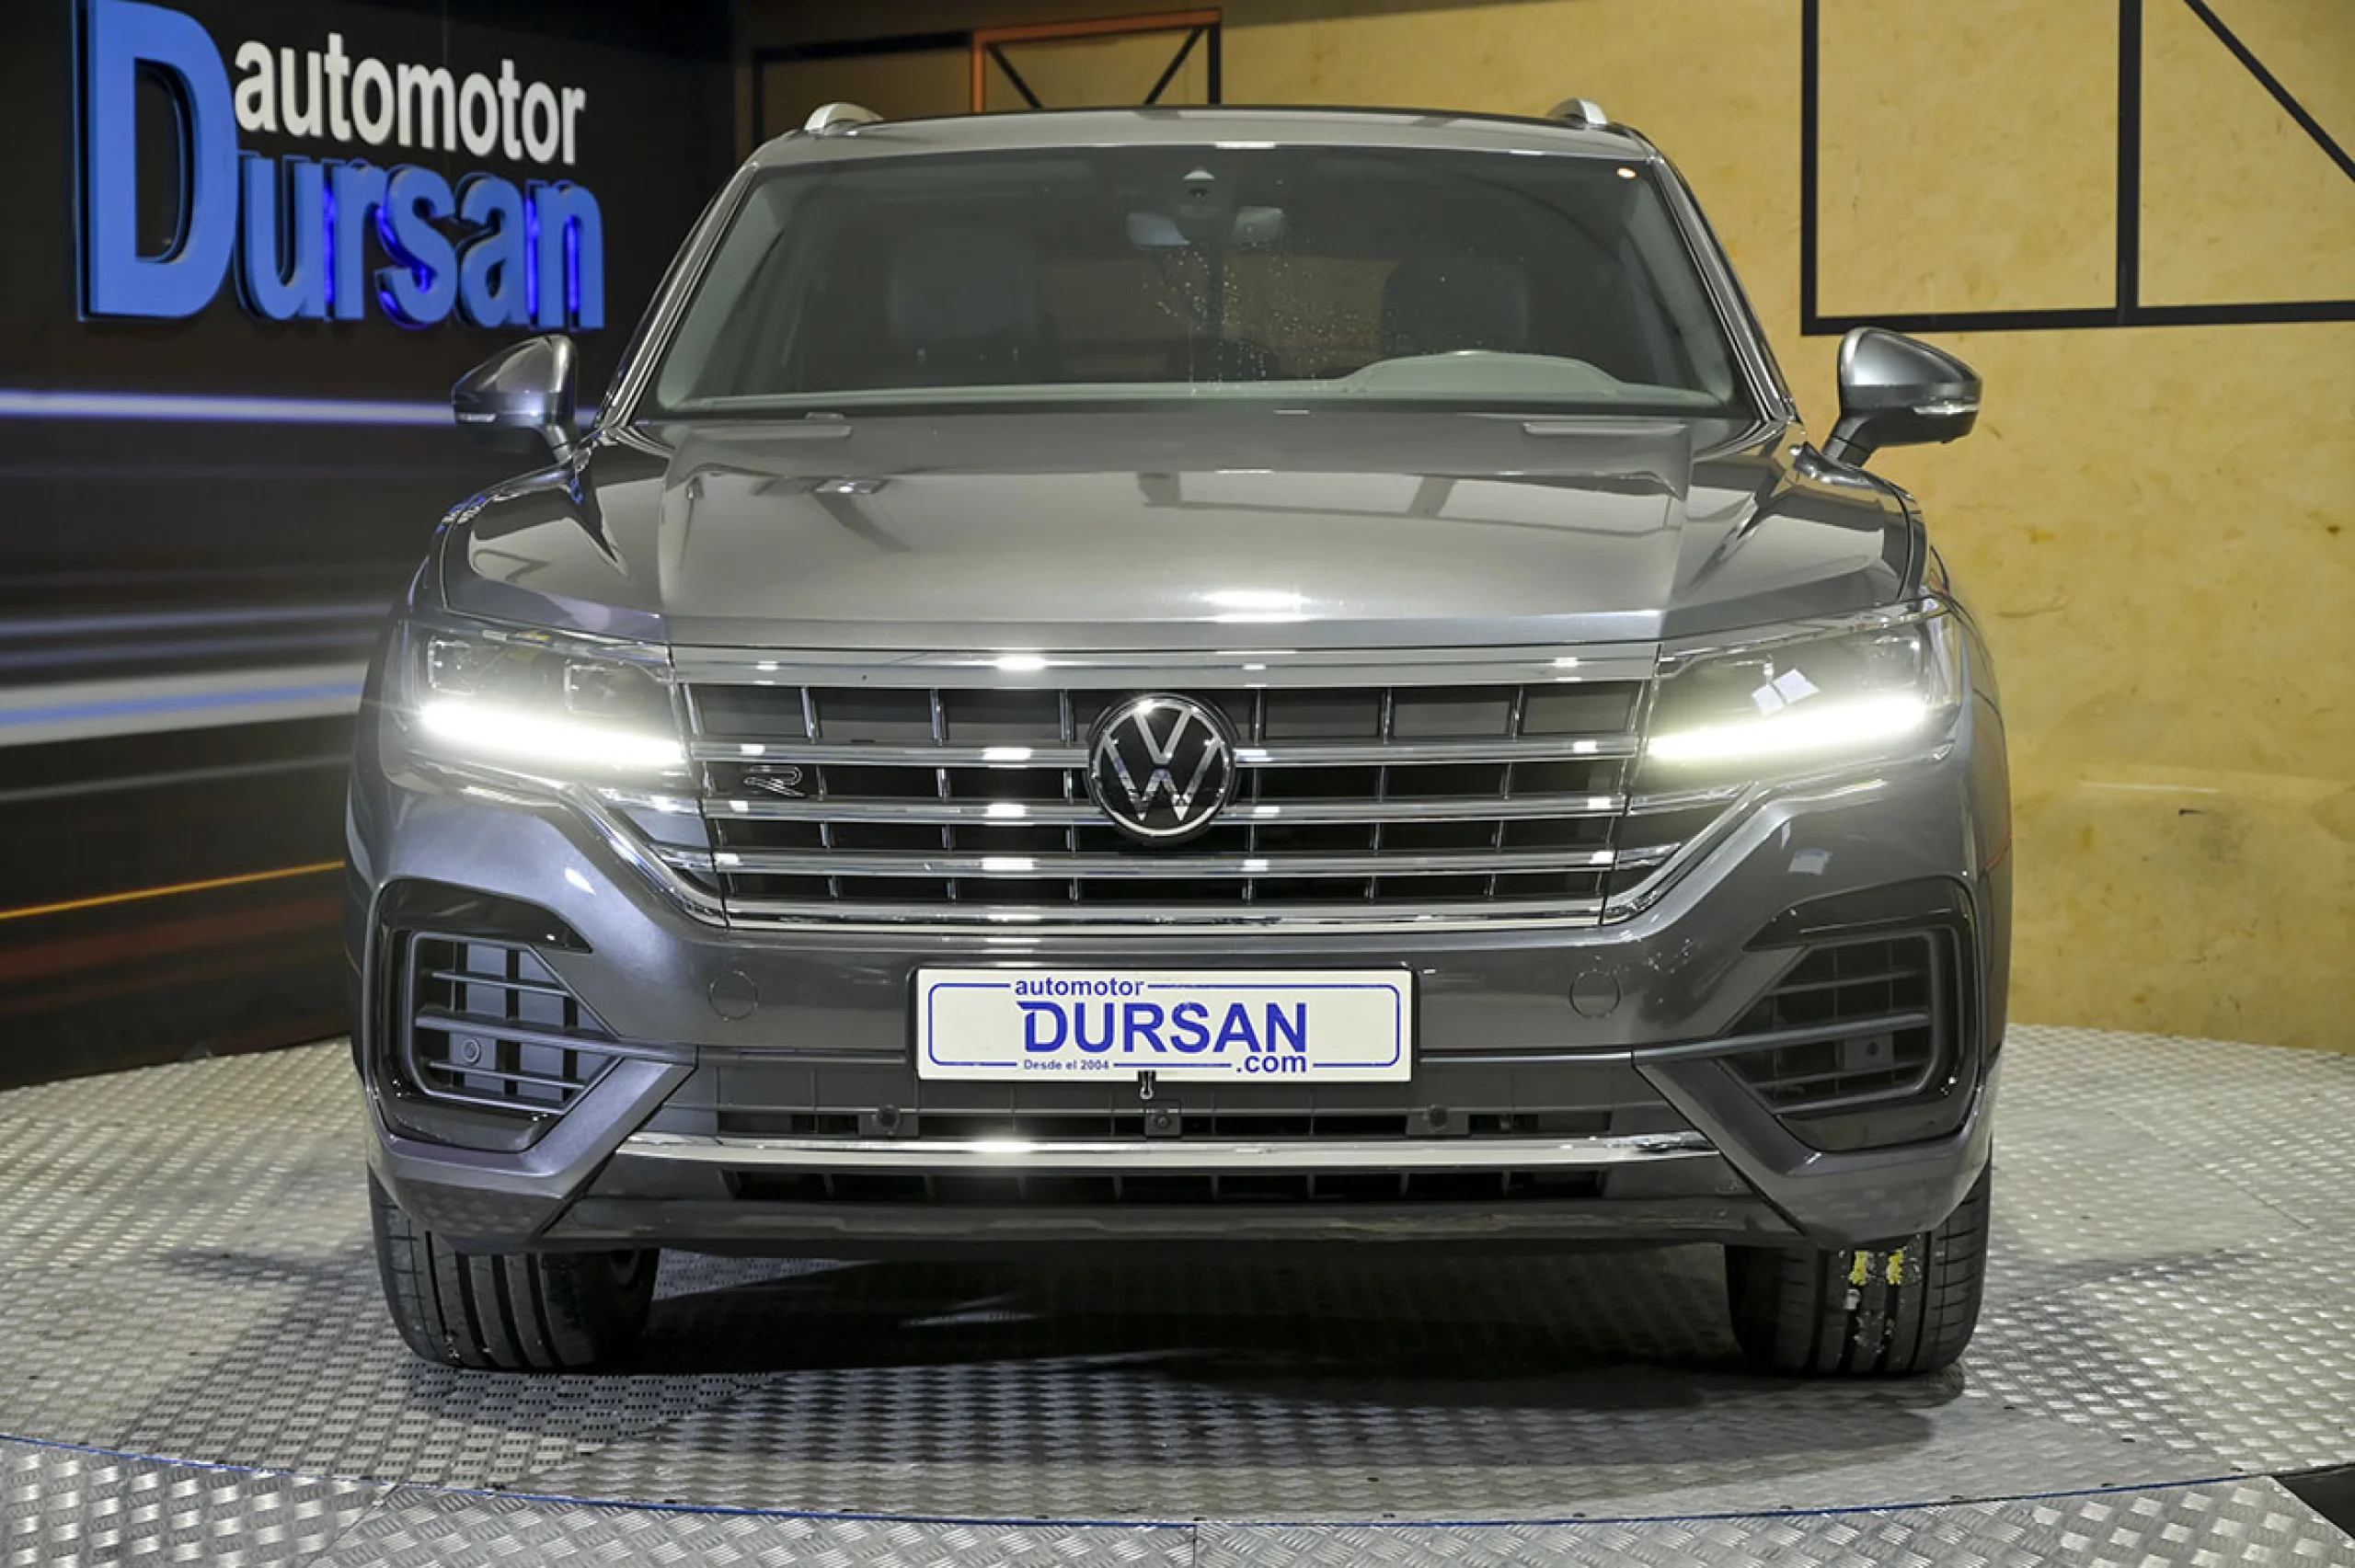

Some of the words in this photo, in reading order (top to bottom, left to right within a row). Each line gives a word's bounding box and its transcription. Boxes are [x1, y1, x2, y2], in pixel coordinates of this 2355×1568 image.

[235, 32, 586, 166] automotor
[77, 0, 604, 331] Dursan
[1015, 978, 1144, 997] automotor
[1017, 1001, 1306, 1053] DURSAN
[1024, 1059, 1062, 1070] Desde
[1065, 1059, 1077, 1070] el
[1080, 1059, 1109, 1070] 2004
[1235, 1053, 1306, 1074] .com
